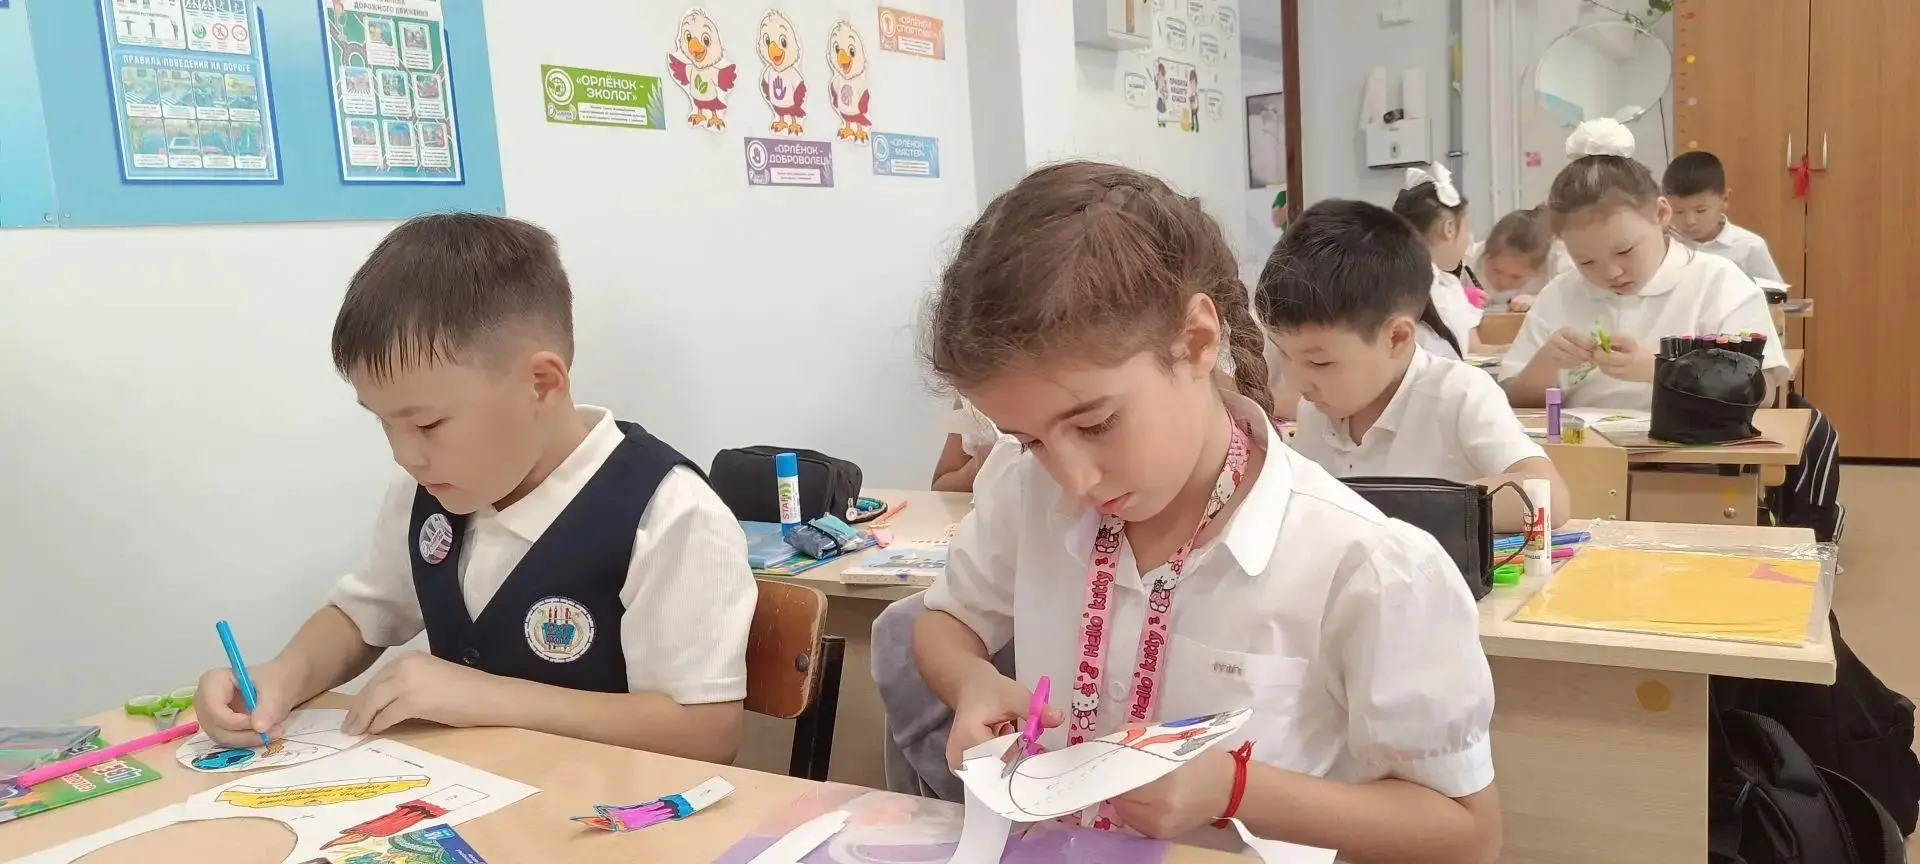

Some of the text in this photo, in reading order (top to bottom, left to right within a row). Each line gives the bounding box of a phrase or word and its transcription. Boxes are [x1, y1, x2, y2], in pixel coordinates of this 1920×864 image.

[123, 54, 250, 72] ПРАВИЛА ПОВЕДЕНИЯ НА ДОРОГЕ
[576, 74, 637, 90] «ОРЛЁНОК
[586, 87, 638, 101] ЭКОЛОГ»
[774, 144, 819, 155] «ОРЛЁНОК
[1085, 570, 1113, 657] Hello kitty
[1131, 630, 1165, 719] Hello kitty
